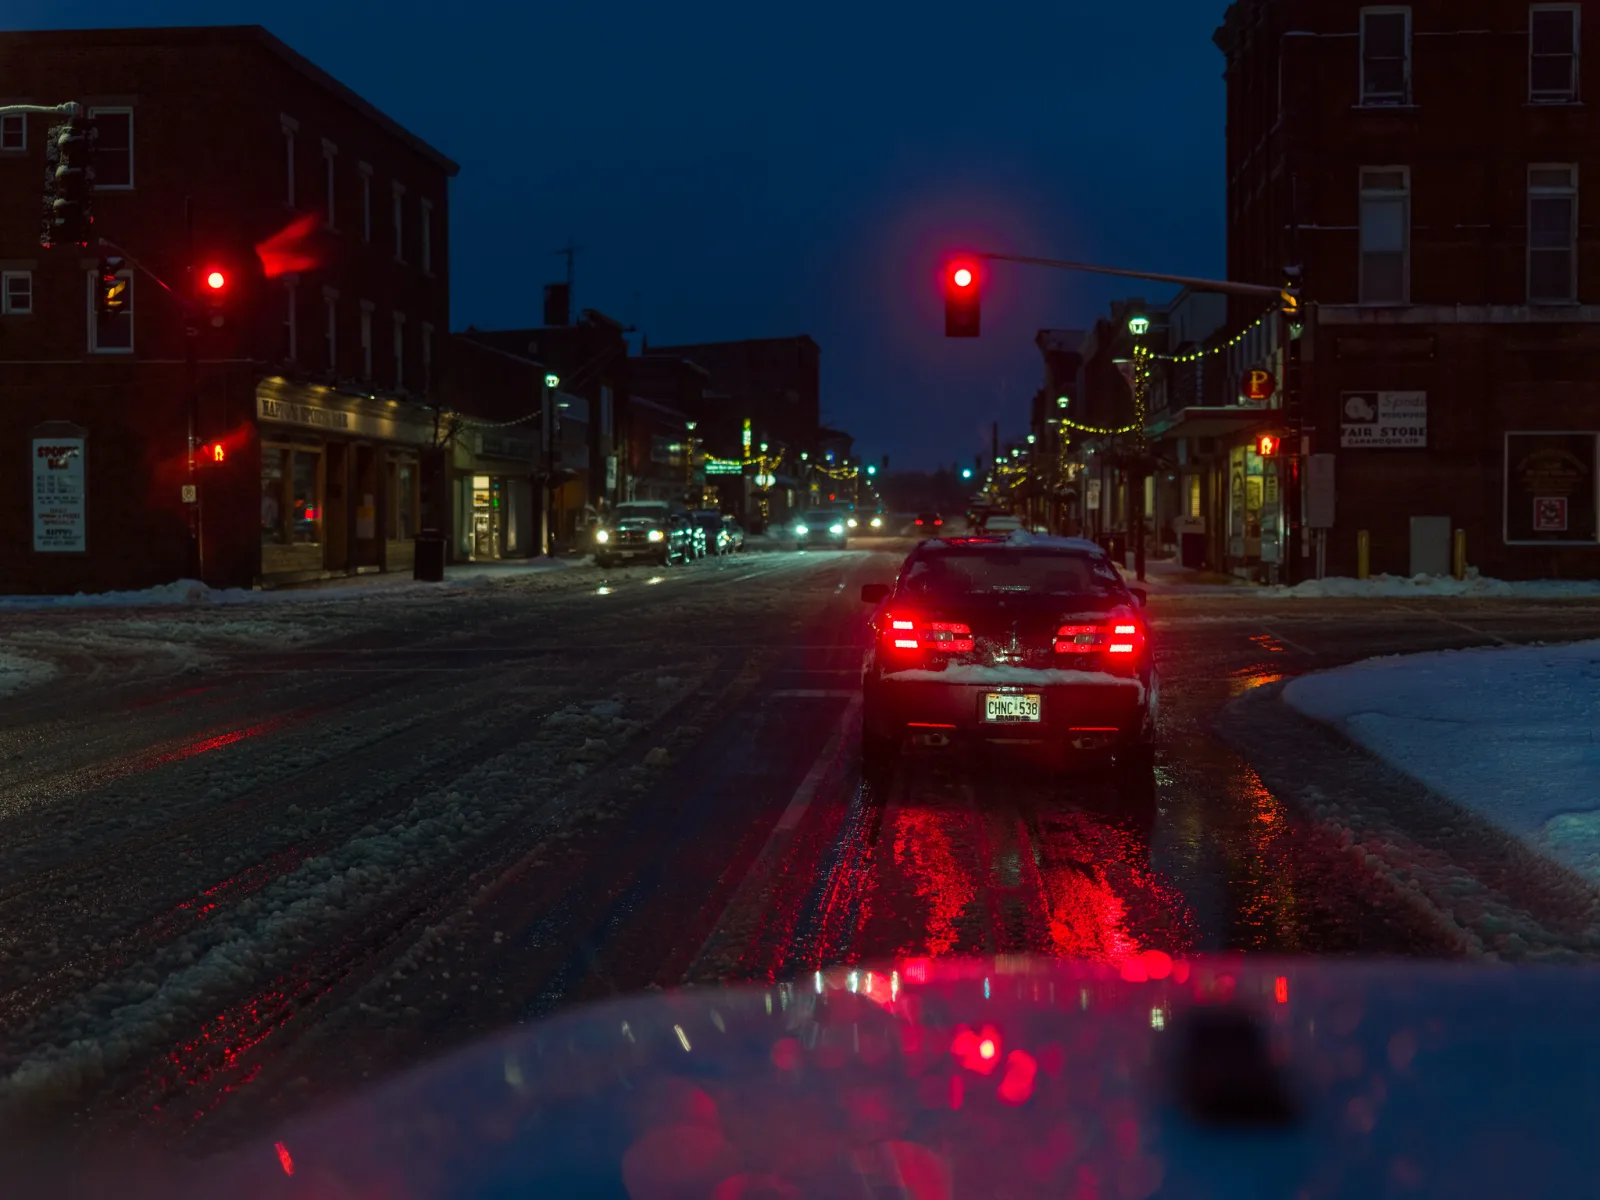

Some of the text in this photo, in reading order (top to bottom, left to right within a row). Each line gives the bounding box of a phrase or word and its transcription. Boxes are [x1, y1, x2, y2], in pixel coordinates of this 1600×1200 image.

[332, 411, 348, 428] BAR
[1380, 426, 1426, 437] STORE
[989, 702, 1037, 715] CHNC 538
